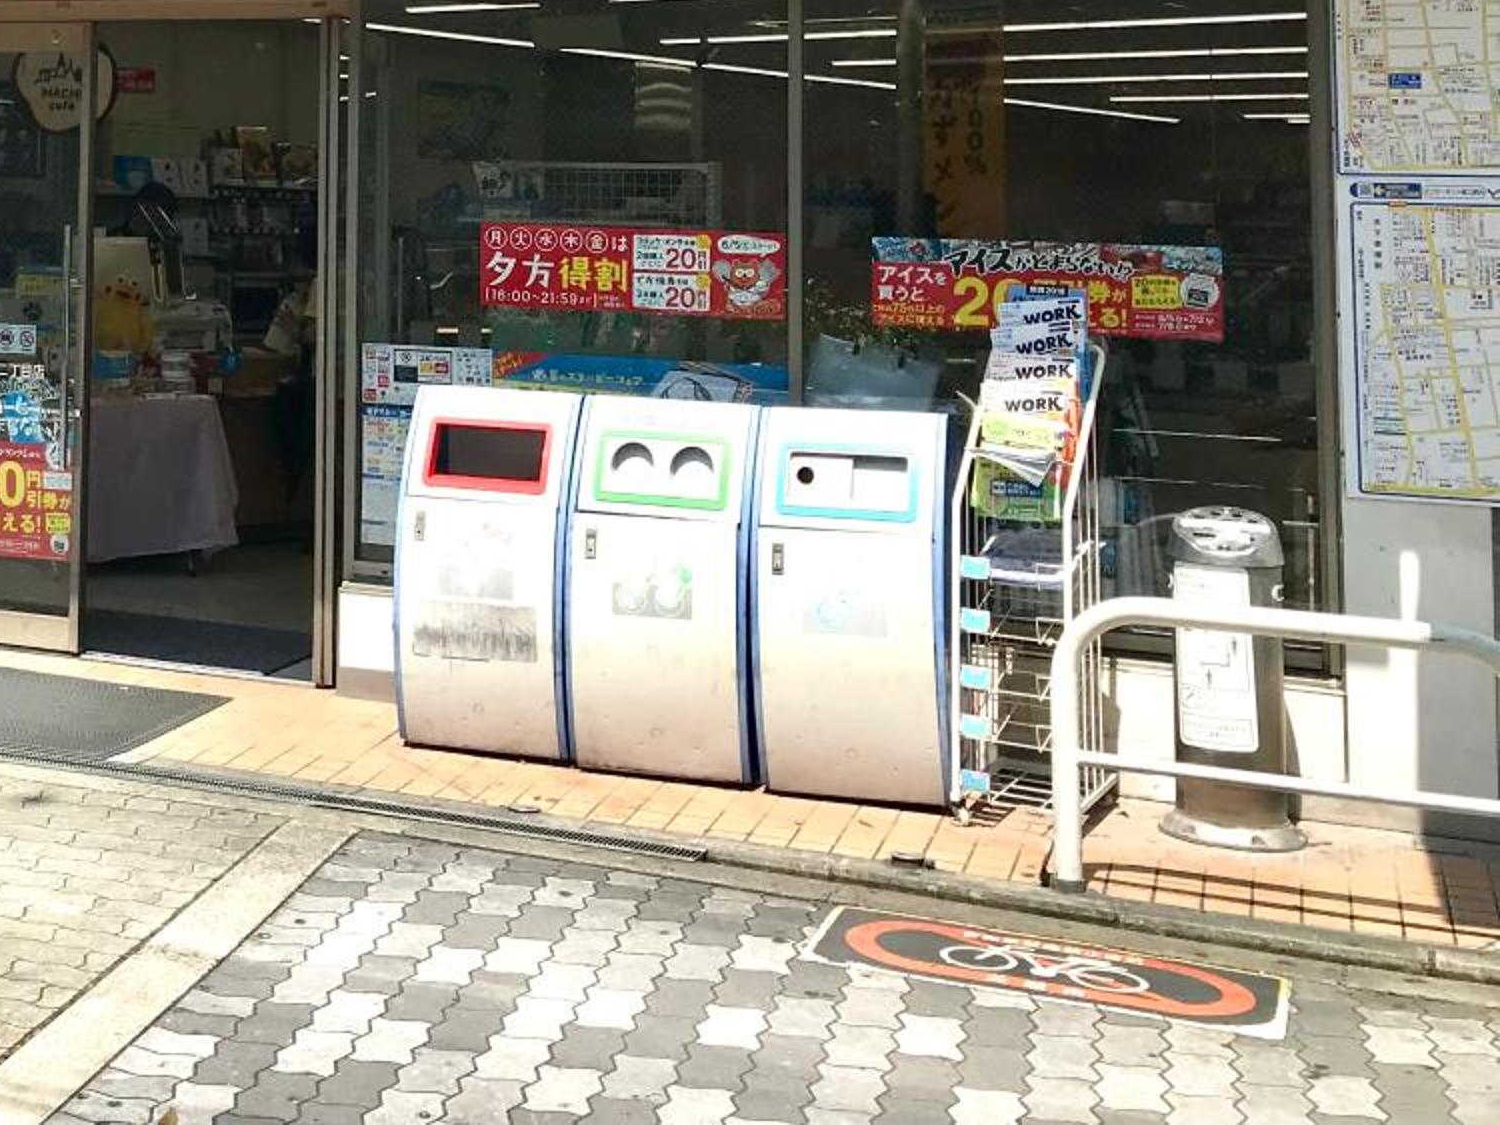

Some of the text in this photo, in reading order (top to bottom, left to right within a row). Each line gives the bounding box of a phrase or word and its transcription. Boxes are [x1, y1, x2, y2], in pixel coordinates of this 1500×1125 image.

[665, 247, 697, 269] 20
[485, 251, 629, 293] 夕方得割
[877, 266, 947, 286] アイスを
[665, 286, 697, 308] 20
[877, 285, 925, 302] 買うと
[1024, 304, 1082, 324] WORK
[1016, 332, 1073, 355] WORK
[1015, 363, 1072, 380] WORK
[1005, 396, 1063, 413] WORK
